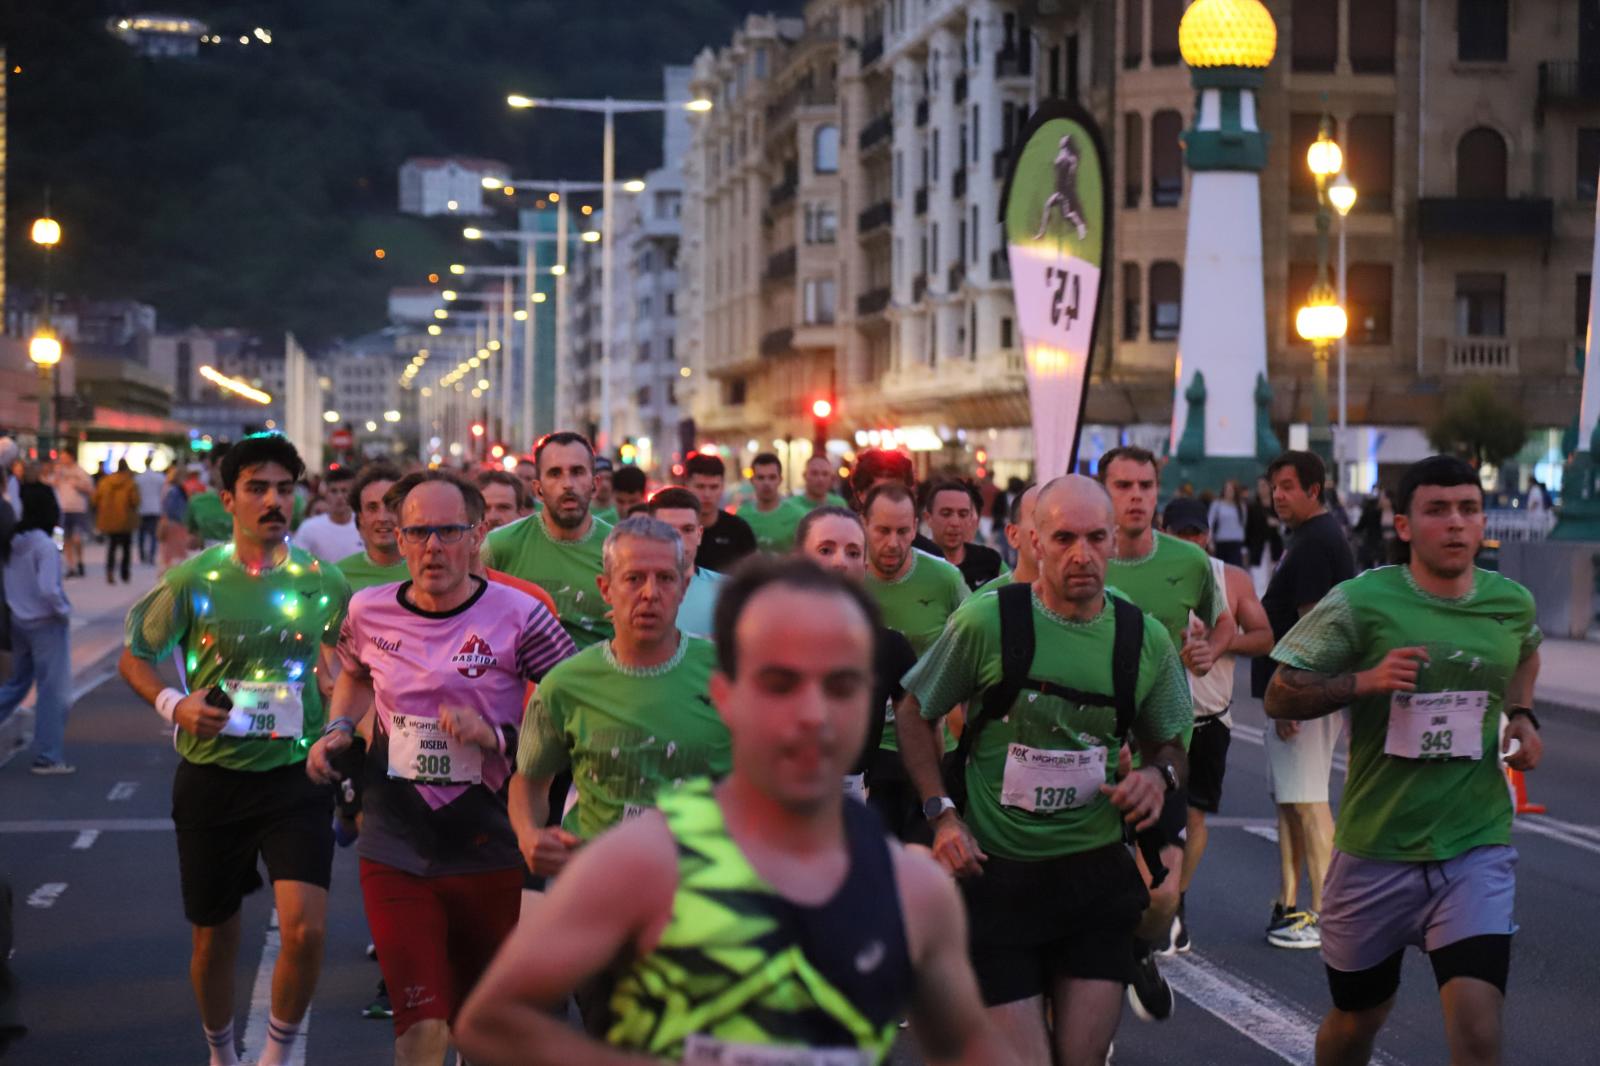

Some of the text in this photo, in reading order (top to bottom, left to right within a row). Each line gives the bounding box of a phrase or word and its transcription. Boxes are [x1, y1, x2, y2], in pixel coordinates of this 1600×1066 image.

[452, 654, 497, 666] BASTIDA
[249, 713, 275, 730] 798
[393, 715, 406, 728] 10K
[420, 740, 448, 750] JOSEBA
[1421, 730, 1453, 752] 343
[1012, 747, 1029, 761] 10K
[417, 754, 451, 774] 308
[1034, 786, 1077, 807] 1378
